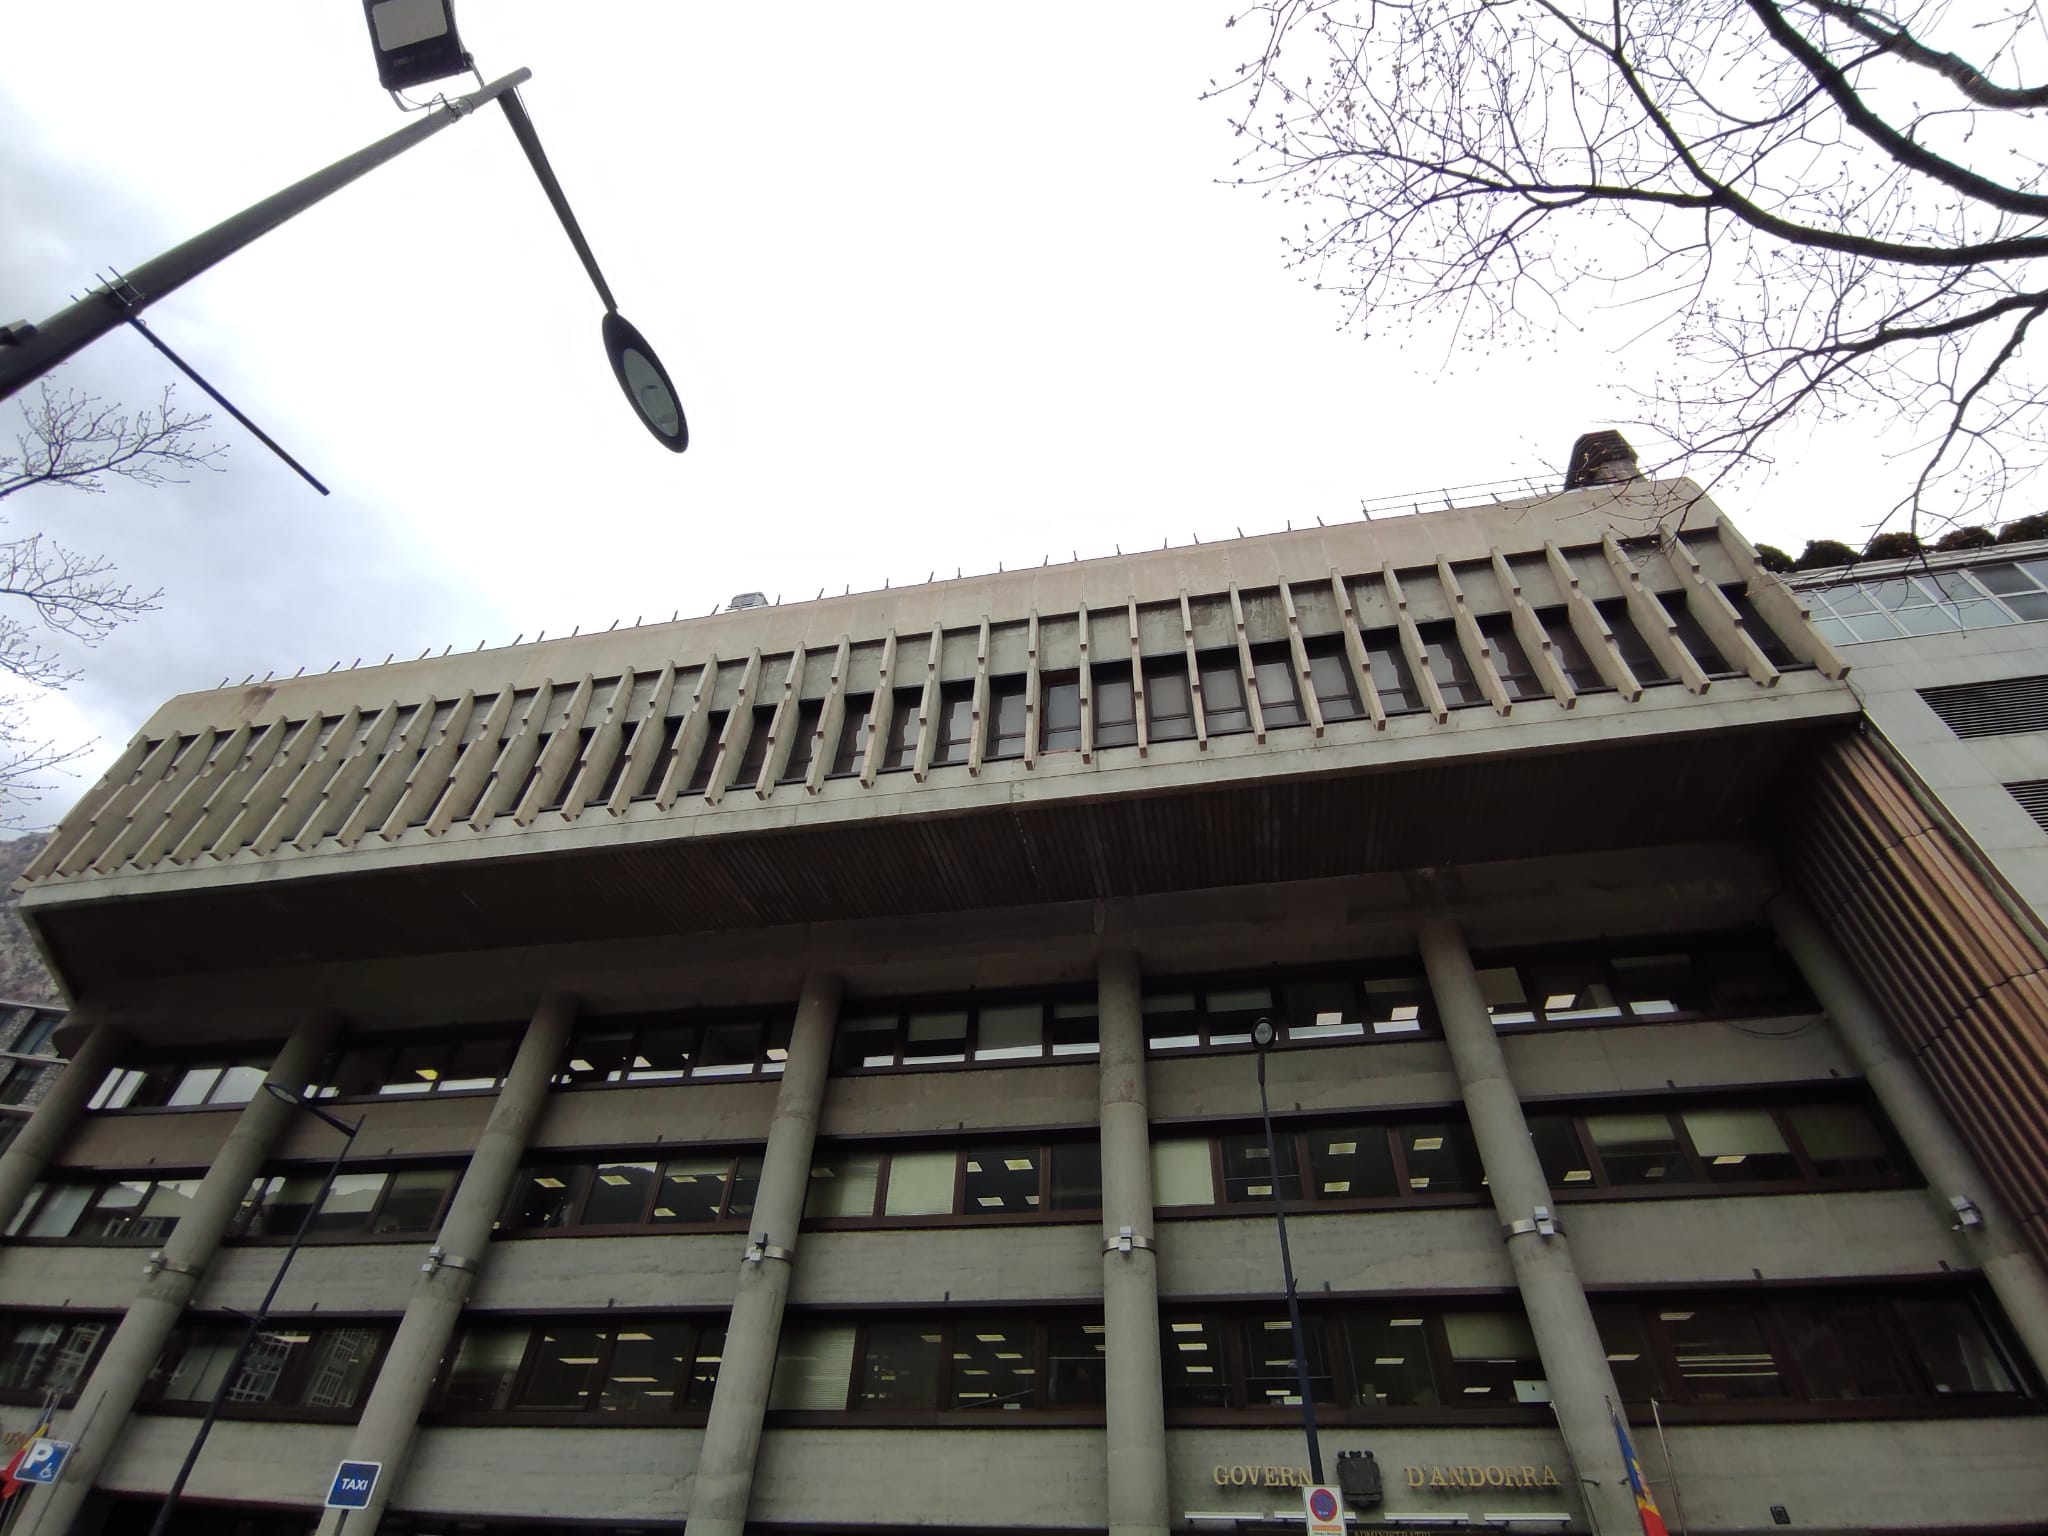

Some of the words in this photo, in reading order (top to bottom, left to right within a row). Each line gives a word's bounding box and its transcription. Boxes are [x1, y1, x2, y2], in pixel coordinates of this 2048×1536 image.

[23, 1439, 54, 1469] P
[342, 1478, 368, 1491] TAXI
[1213, 1465, 1313, 1487] GOVERN
[1404, 1464, 1560, 1487] D'ANDORRA
